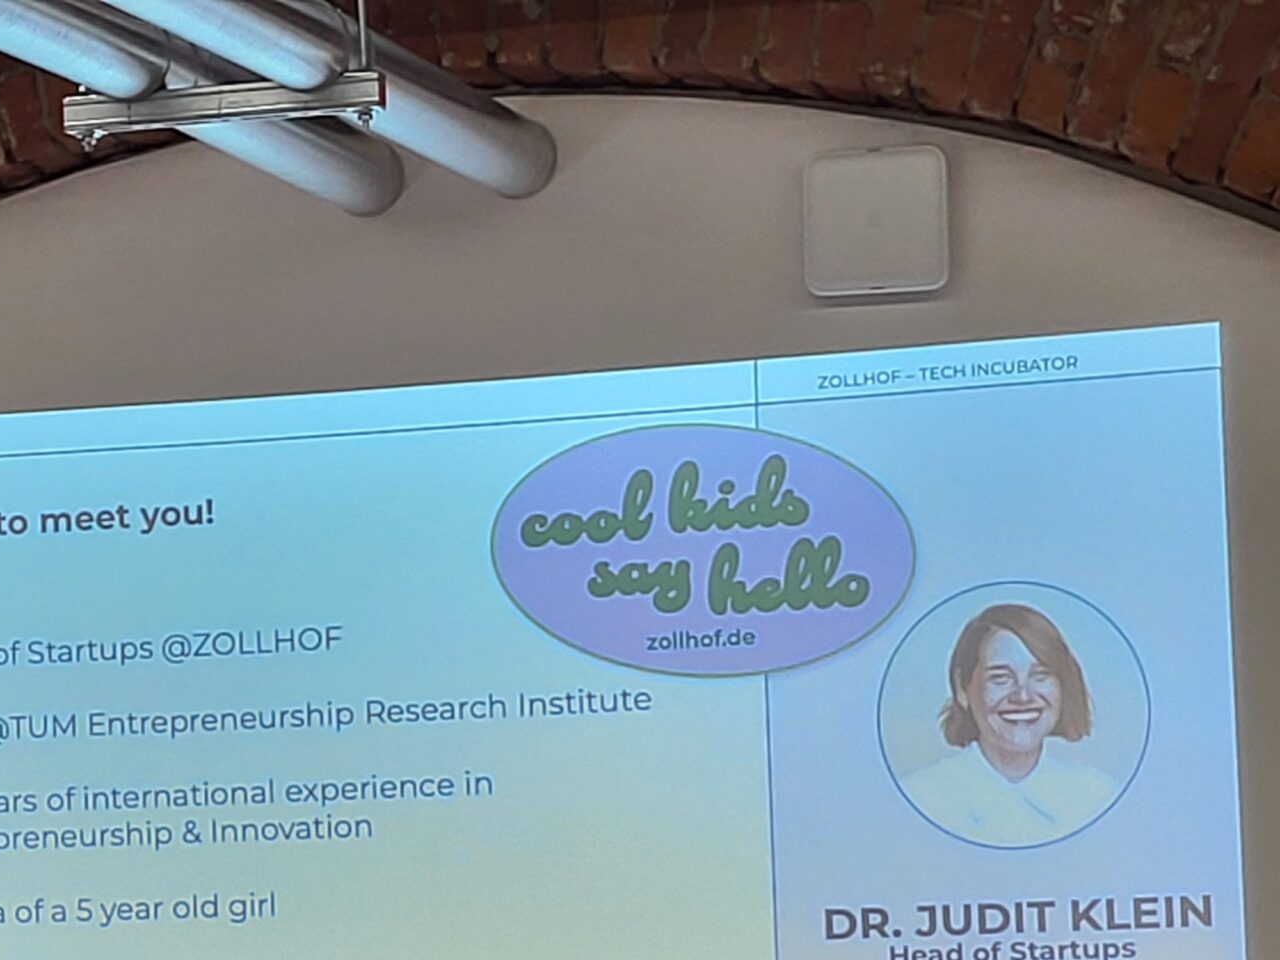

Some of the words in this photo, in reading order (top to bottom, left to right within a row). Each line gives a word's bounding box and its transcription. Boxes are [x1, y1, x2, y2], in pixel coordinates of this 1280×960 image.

[818, 370, 902, 389] ZOLLHOF
[918, 365, 966, 382] TECH
[971, 355, 1078, 377] INCUBATOR
[39, 503, 130, 533] meet
[139, 499, 215, 534] you!
[521, 468, 654, 548] cool
[668, 453, 810, 534] kids
[587, 559, 691, 614] say
[707, 536, 870, 615] hello
[26, 636, 154, 666] Startups
[161, 625, 343, 664] @ZOLLHOF
[646, 629, 756, 651] zollhof.de
[88, 702, 355, 738] Entrepreneurship
[365, 693, 507, 724] Research
[519, 688, 653, 718] Institute
[46, 786, 77, 812] of
[83, 778, 274, 810] international
[285, 775, 455, 806] experience
[464, 770, 494, 796] in
[182, 820, 202, 844] &
[211, 813, 373, 843] Innovation
[15, 898, 44, 923] of
[50, 903, 67, 923] a
[75, 898, 93, 922] 5
[99, 900, 163, 927] year
[172, 893, 218, 920] old
[228, 891, 275, 924] girl
[824, 907, 902, 940] DR.
[914, 901, 1056, 937] JUDIT
[1070, 895, 1213, 931] KLEIN
